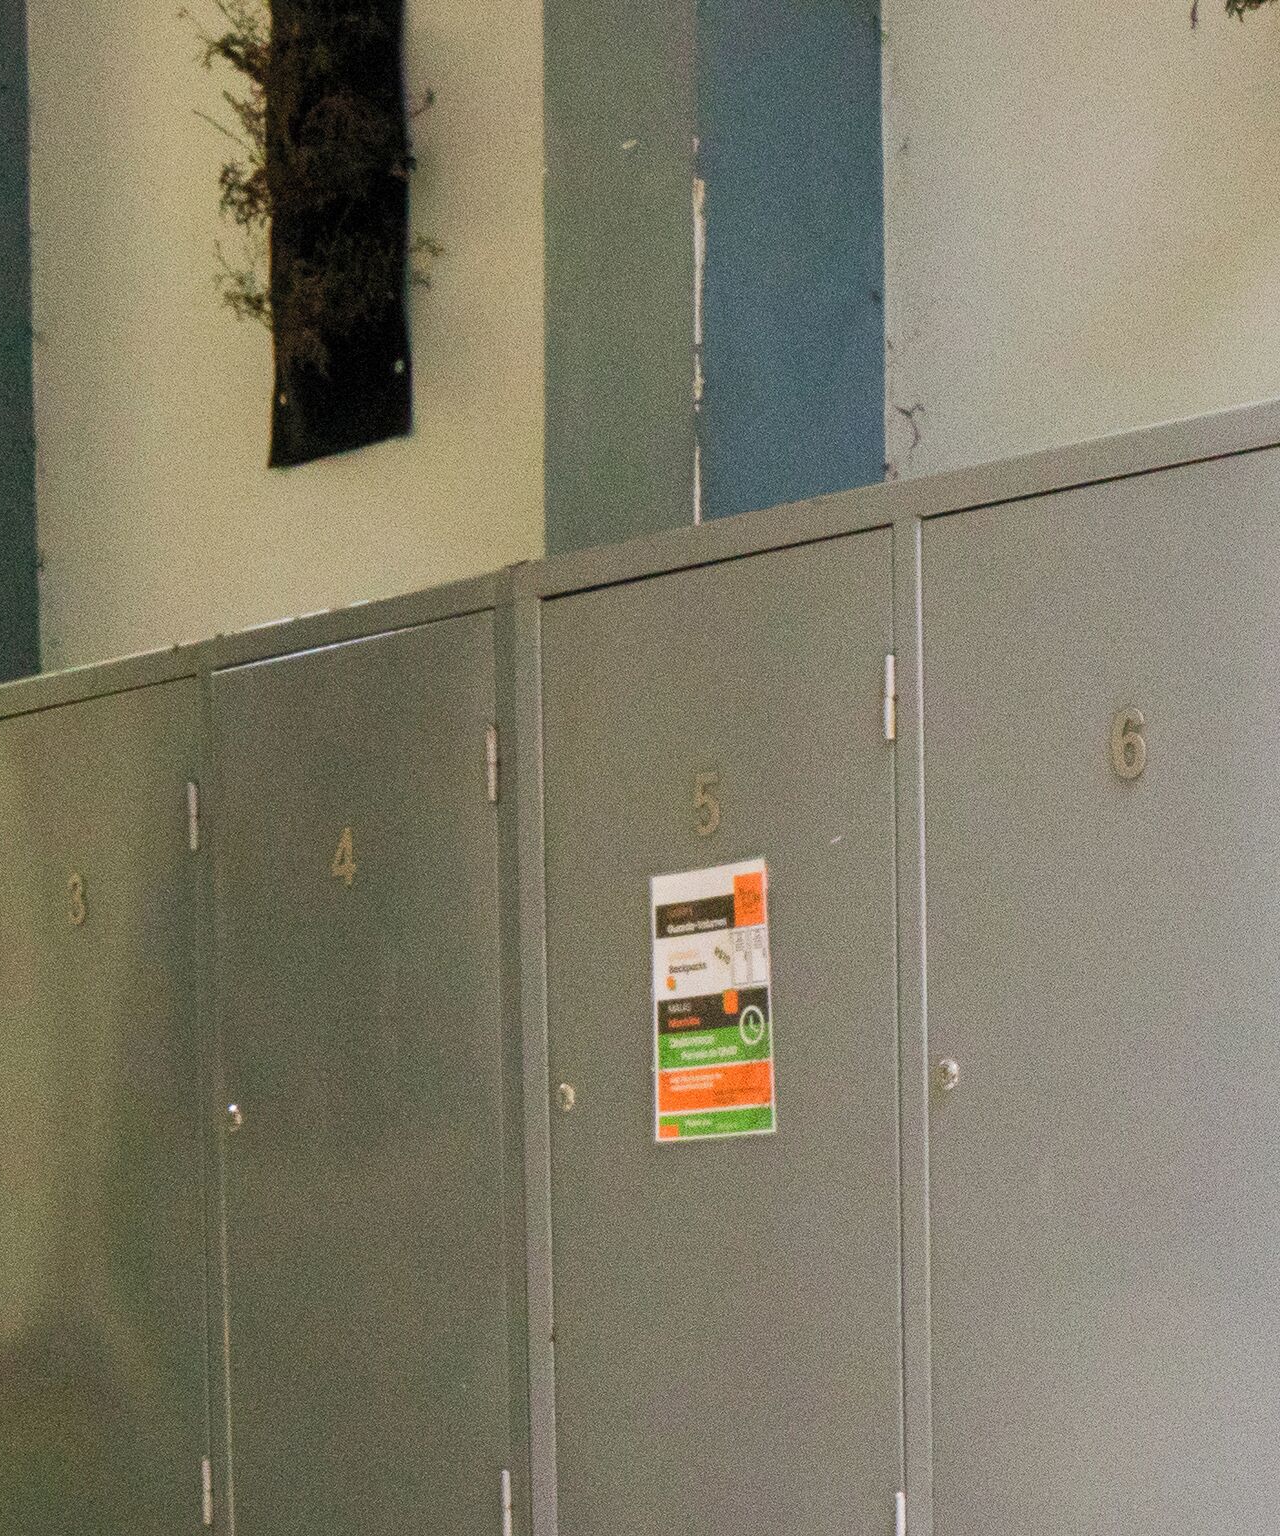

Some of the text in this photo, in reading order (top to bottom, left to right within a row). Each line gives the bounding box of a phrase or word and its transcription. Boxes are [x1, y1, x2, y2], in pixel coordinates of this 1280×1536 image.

[1109, 708, 1148, 781] 6
[692, 772, 720, 837] 5
[329, 826, 358, 890] 4
[67, 872, 89, 926] 3
